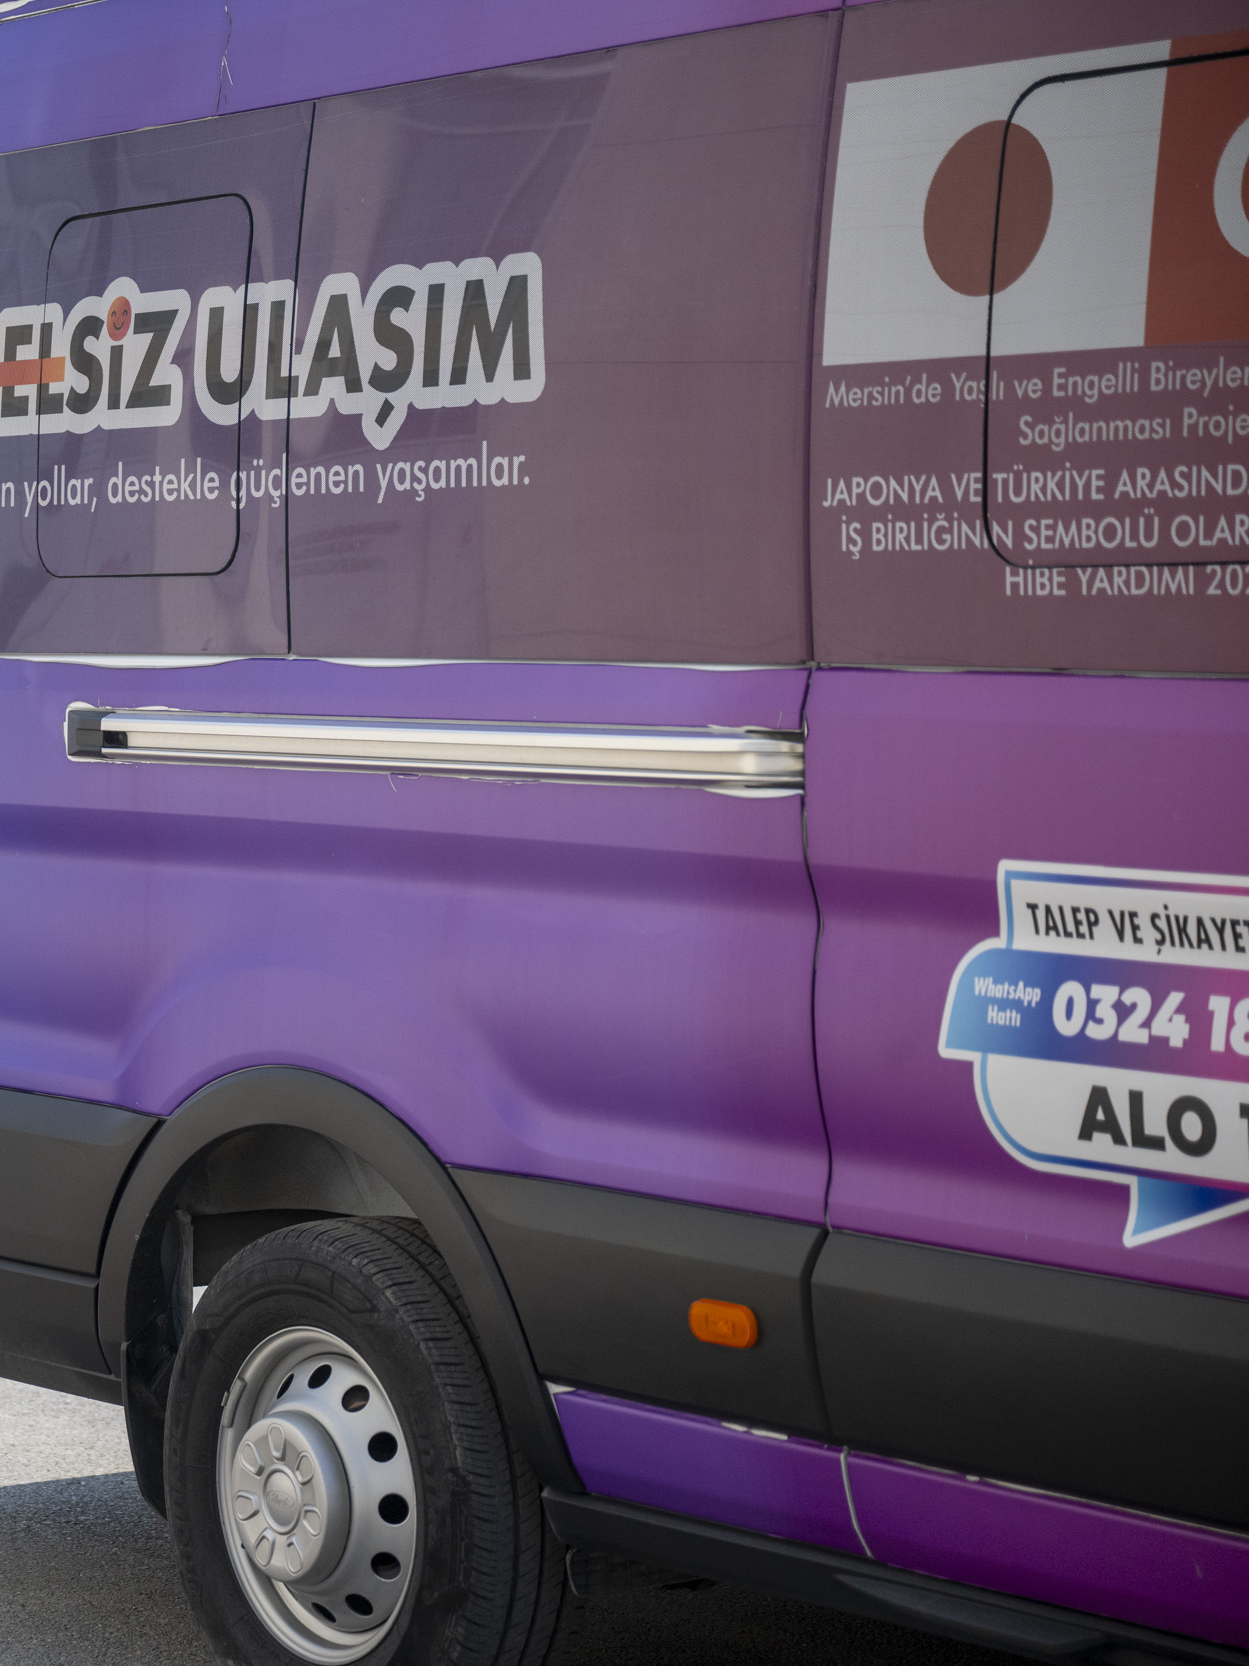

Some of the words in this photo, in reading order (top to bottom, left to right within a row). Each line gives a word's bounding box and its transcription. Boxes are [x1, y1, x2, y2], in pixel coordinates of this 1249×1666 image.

[203, 274, 532, 429] ULAŞIM
[950, 370, 1005, 408] Yaşlı
[1014, 377, 1043, 399] ve
[1052, 361, 1140, 403] Engelli
[1018, 411, 1171, 452] Sağlanması
[1182, 404, 1249, 445] Proje
[23, 463, 98, 518] yollar,
[108, 458, 220, 505] destekle
[229, 450, 366, 510] güçlenen
[376, 440, 531, 504] yaşamlar.
[822, 473, 943, 508] JAPONYA
[951, 472, 983, 503] VE
[992, 462, 1106, 503] TÜRKİYE
[1114, 464, 1249, 499] ARASIND
[840, 513, 863, 560] İŞ
[871, 512, 1014, 552] BİRLİĞİNİN
[1023, 507, 1160, 550] SEMBOLÜ
[1005, 560, 1067, 597] HİBE
[1076, 564, 1195, 596] YARDIMI
[1205, 563, 1249, 596] 20
[1025, 901, 1100, 941] TALEP
[1107, 909, 1144, 945] VE
[1150, 903, 1249, 956] ŞİKAYE
[973, 976, 1042, 1007] WhatsApp
[986, 1005, 1021, 1028] Hattı
[1052, 980, 1191, 1049] 0324
[1077, 1084, 1218, 1159] ALO
